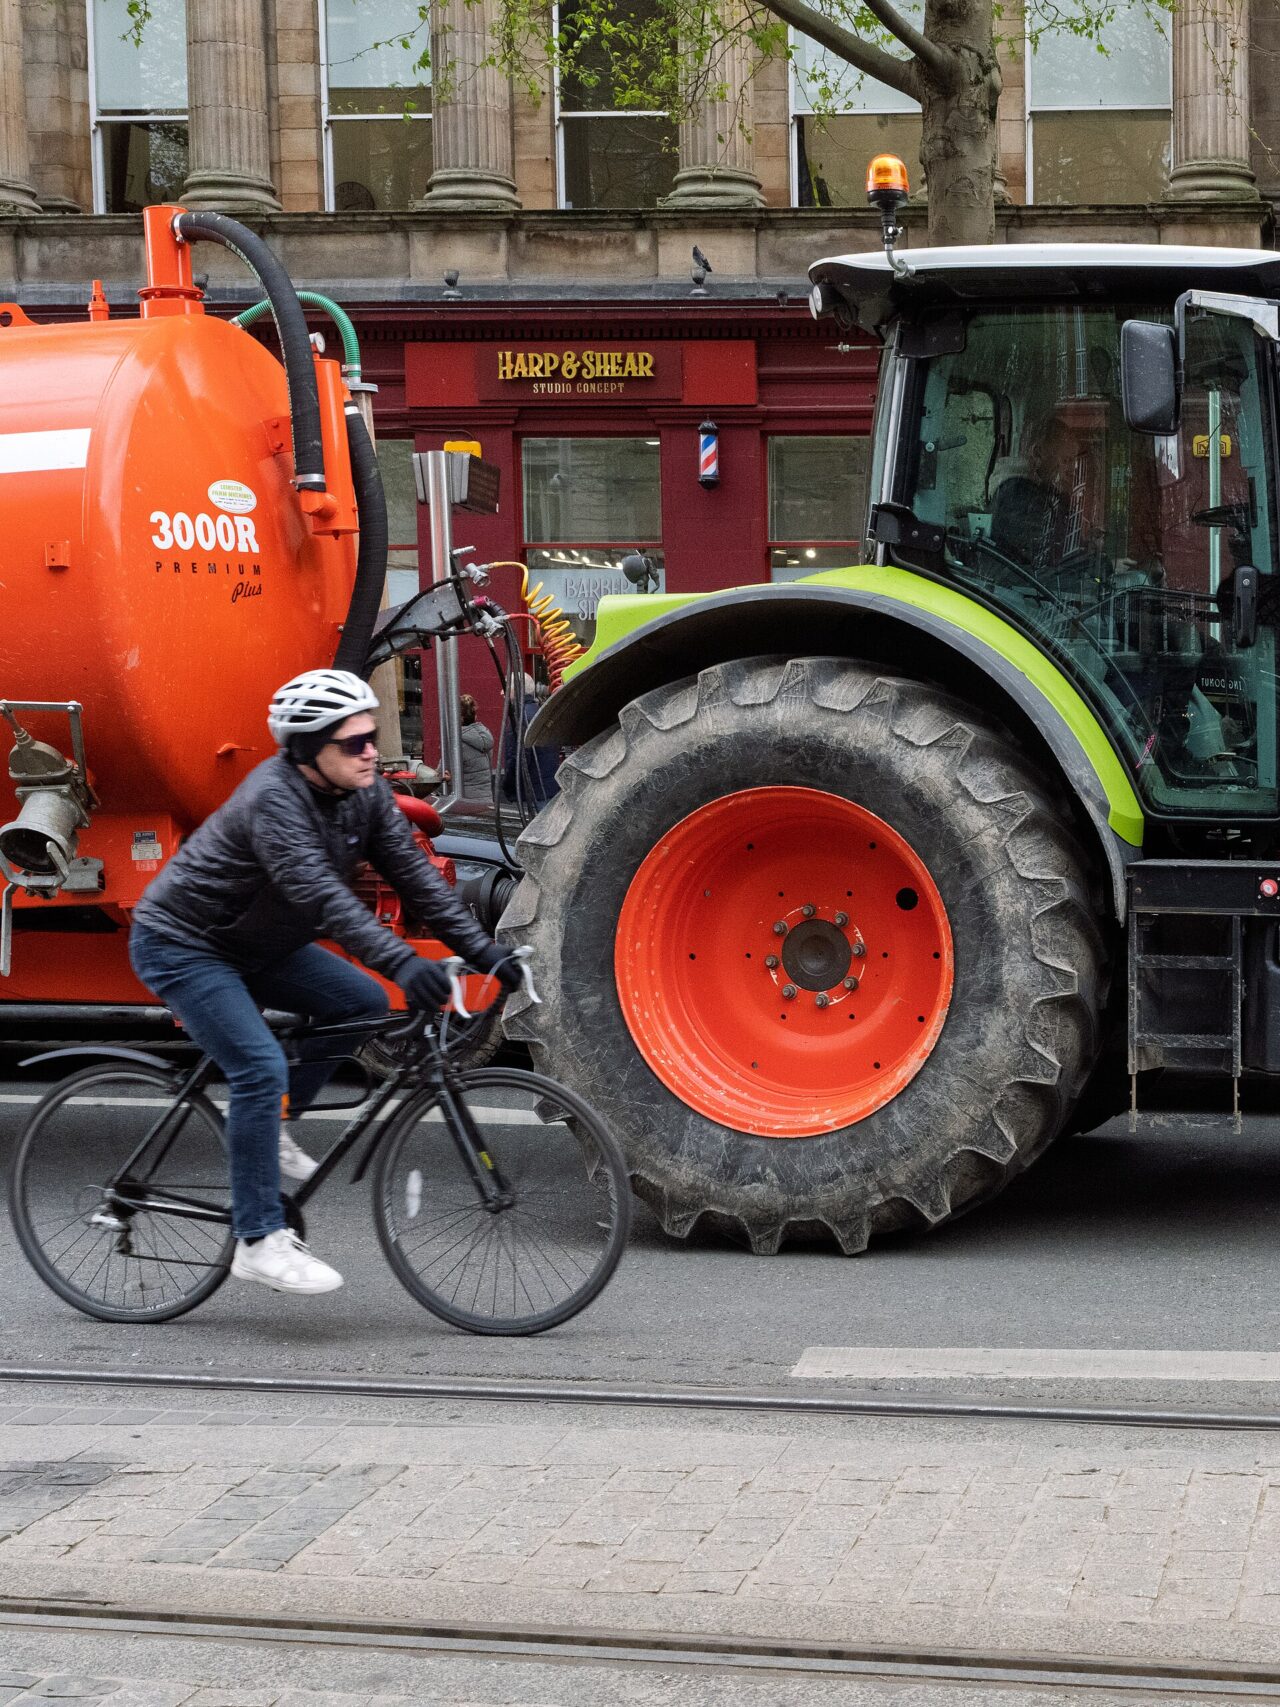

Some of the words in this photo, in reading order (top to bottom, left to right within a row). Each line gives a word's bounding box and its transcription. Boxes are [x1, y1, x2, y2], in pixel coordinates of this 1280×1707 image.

[498, 351, 560, 380] HARP
[561, 351, 581, 379] &
[581, 350, 656, 380] SHEAR
[532, 382, 572, 394] STUDIO
[576, 382, 625, 394] CONCEPT
[149, 510, 260, 554] 3000R
[155, 561, 261, 576] PREMIUM
[231, 581, 262, 603] Plus
